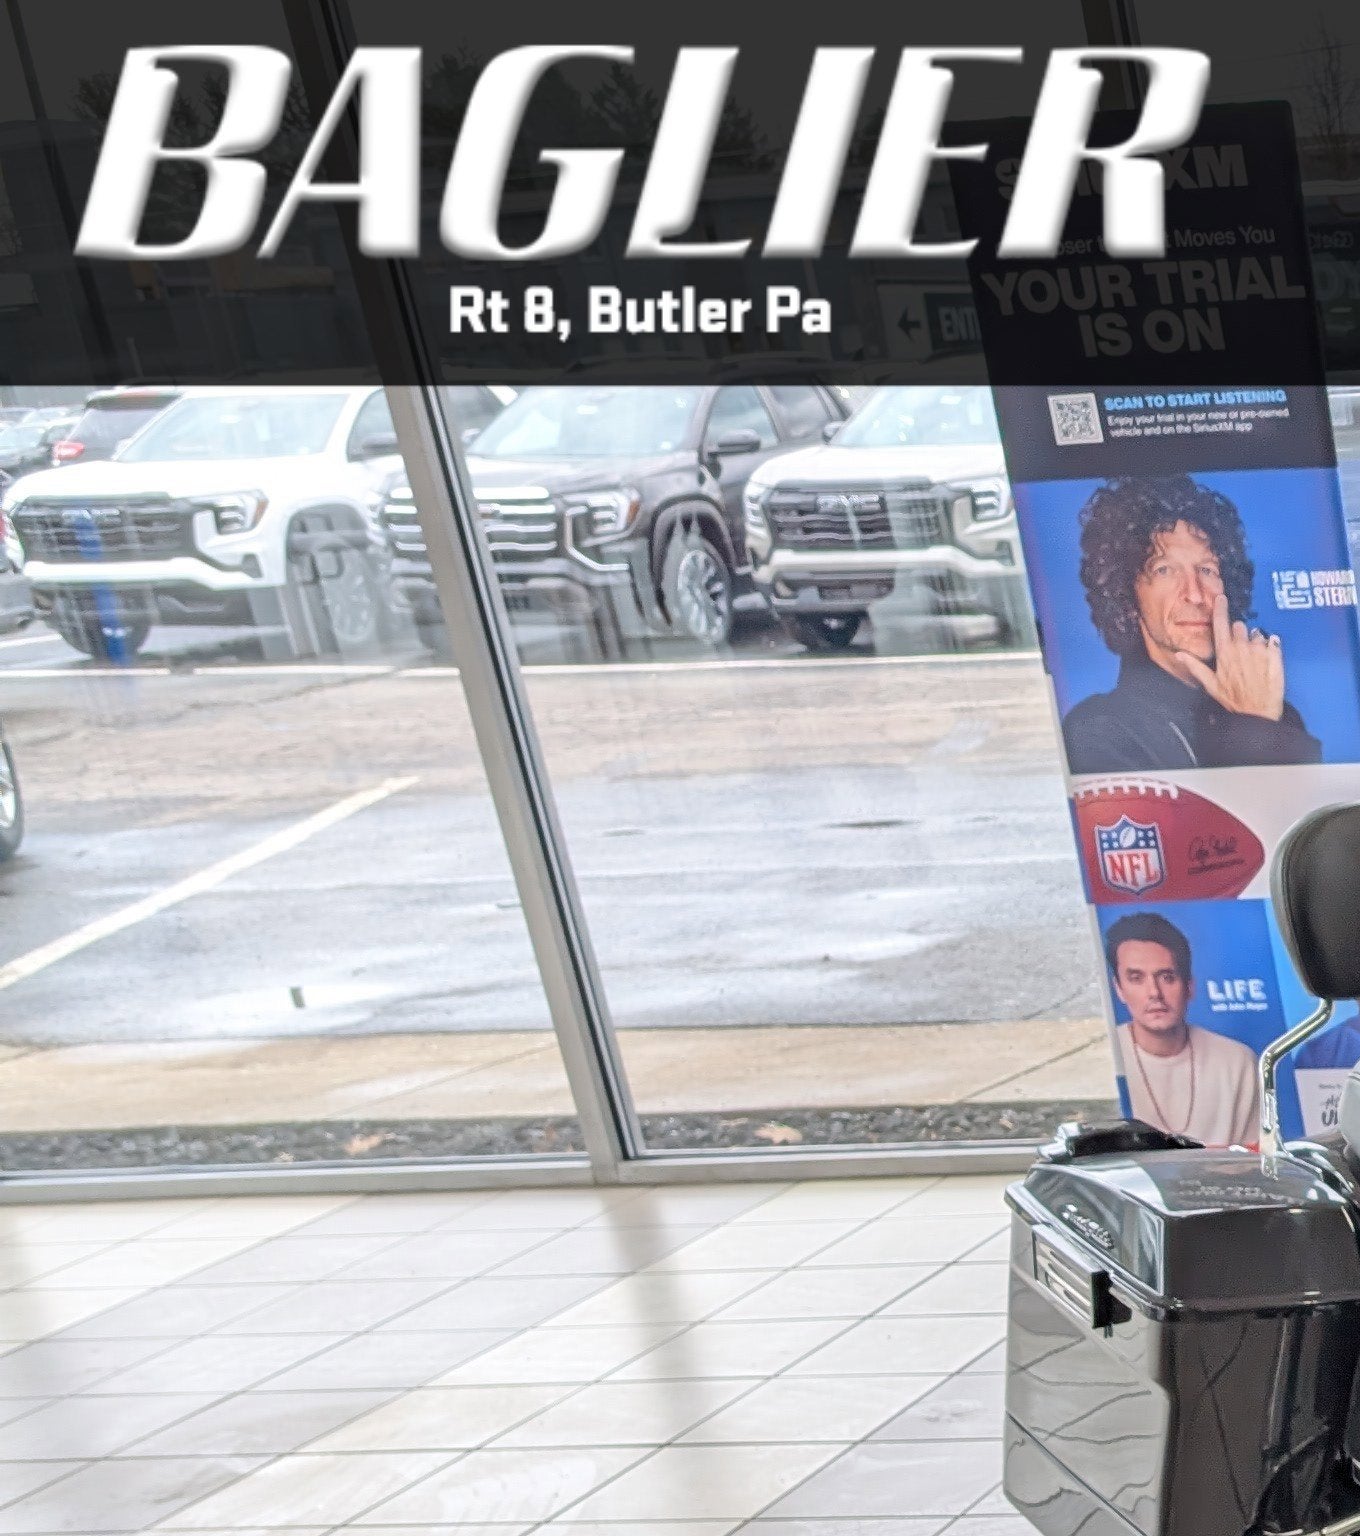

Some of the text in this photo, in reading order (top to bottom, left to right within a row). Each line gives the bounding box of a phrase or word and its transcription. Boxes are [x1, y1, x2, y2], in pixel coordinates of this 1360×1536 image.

[1174, 227, 1237, 248] Moves
[1238, 224, 1276, 246] You
[981, 264, 1138, 317] YOUR
[1142, 255, 1307, 305] TRIAL
[1078, 308, 1227, 358] IS ON
[1104, 389, 1288, 411] SCAN TO START LISTENING
[1106, 851, 1159, 887] NFL
[1207, 979, 1267, 1001] LIFE
